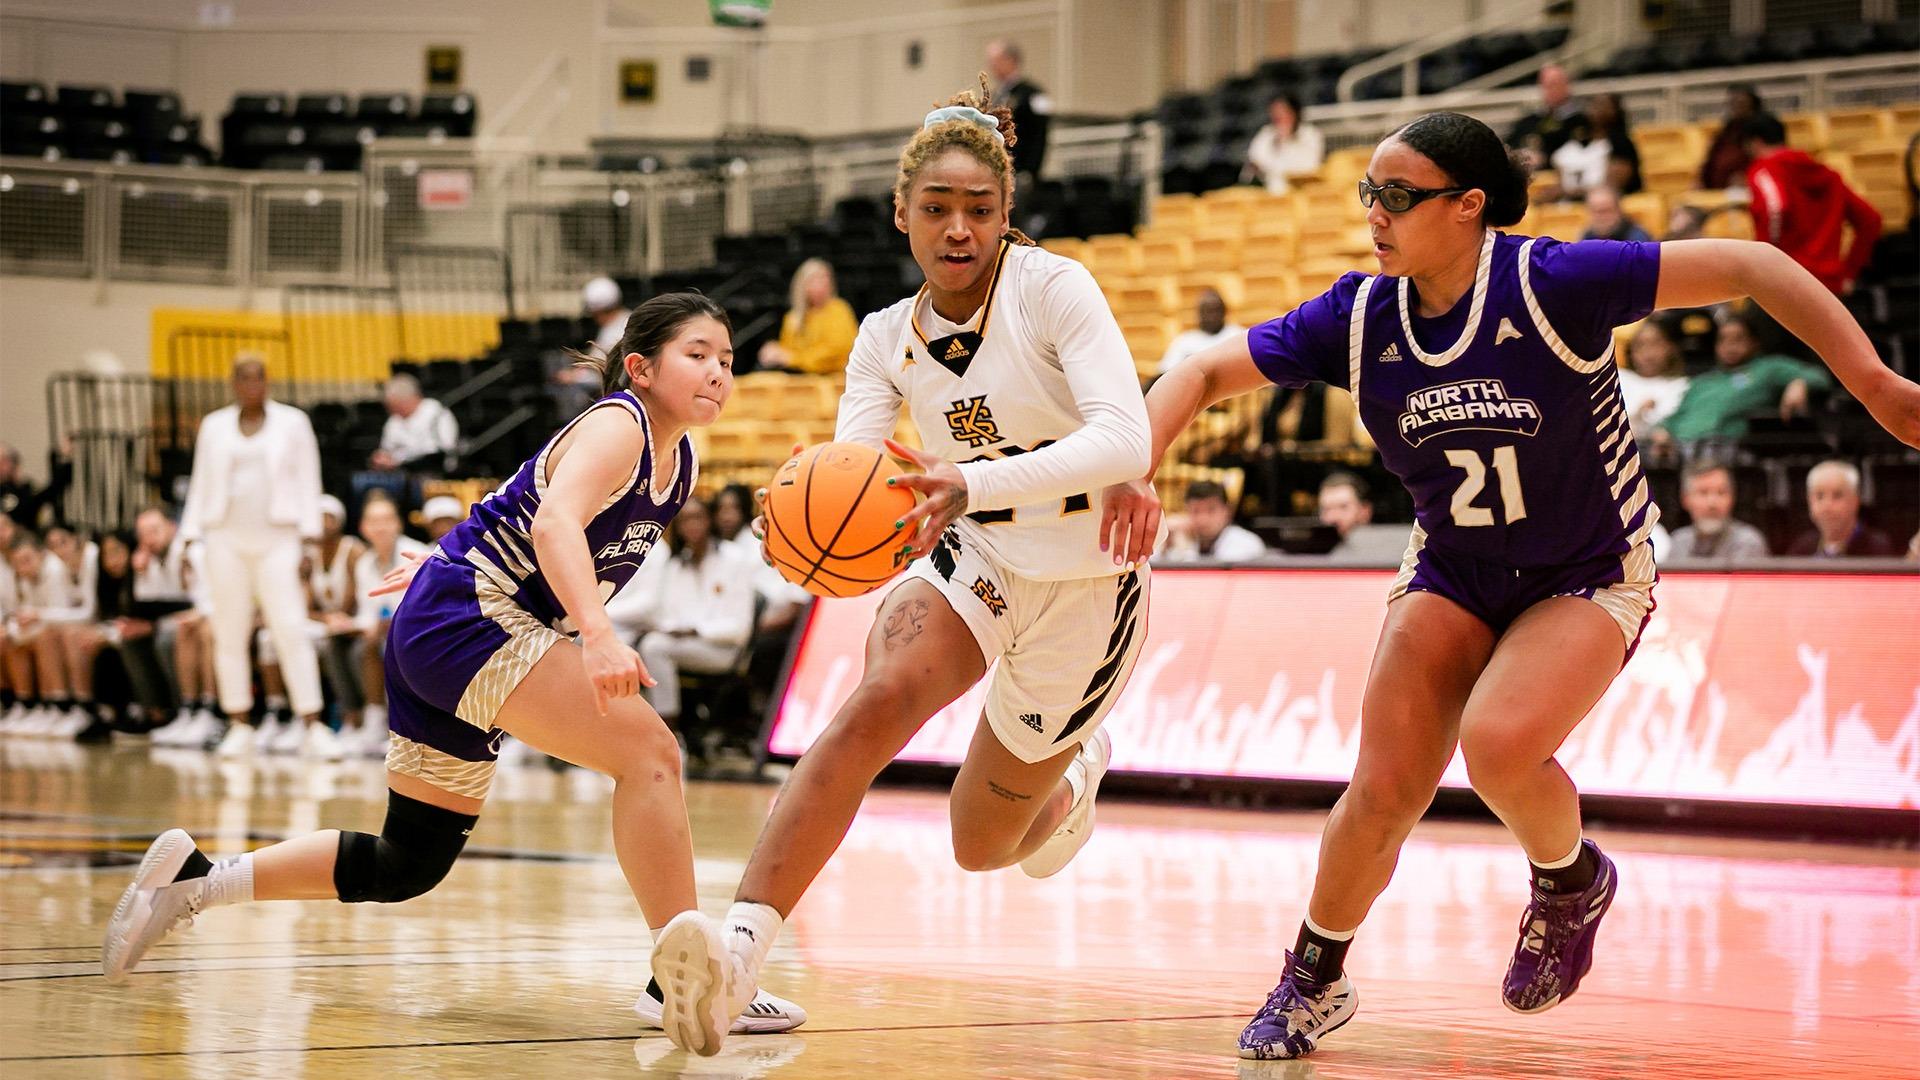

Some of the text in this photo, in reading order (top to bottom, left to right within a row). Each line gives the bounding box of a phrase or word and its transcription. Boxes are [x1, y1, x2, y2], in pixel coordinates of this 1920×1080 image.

[944, 349, 970, 361] adidas
[1379, 354, 1403, 362] adidas
[1410, 382, 1504, 414] NORTH
[1400, 401, 1538, 434] ALABAMA
[1443, 445, 1527, 527] 21
